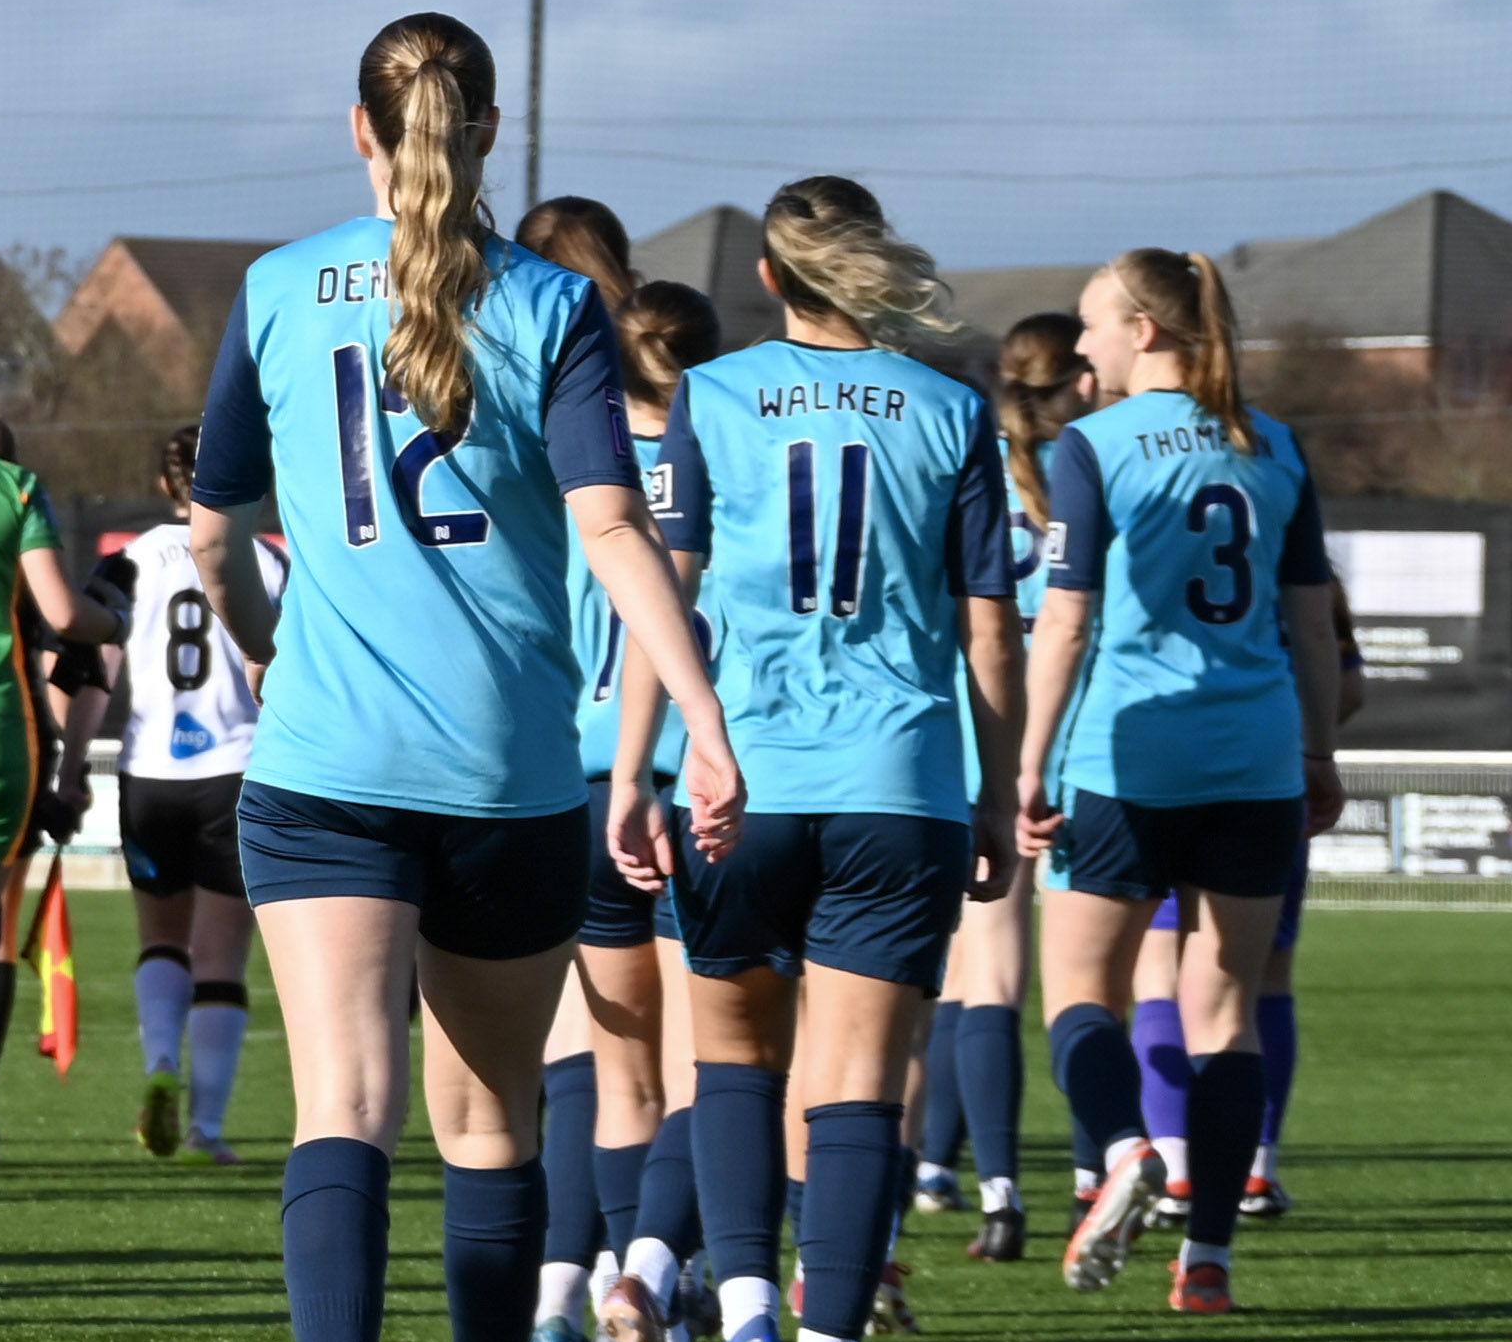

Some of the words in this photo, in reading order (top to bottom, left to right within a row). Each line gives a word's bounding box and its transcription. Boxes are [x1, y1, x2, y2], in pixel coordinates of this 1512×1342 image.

[333, 343, 492, 548] 12
[759, 382, 906, 422] WALKER
[787, 440, 869, 619] 11
[1186, 483, 1254, 625] 3
[167, 588, 212, 691] 8
[173, 725, 208, 749] hsg
